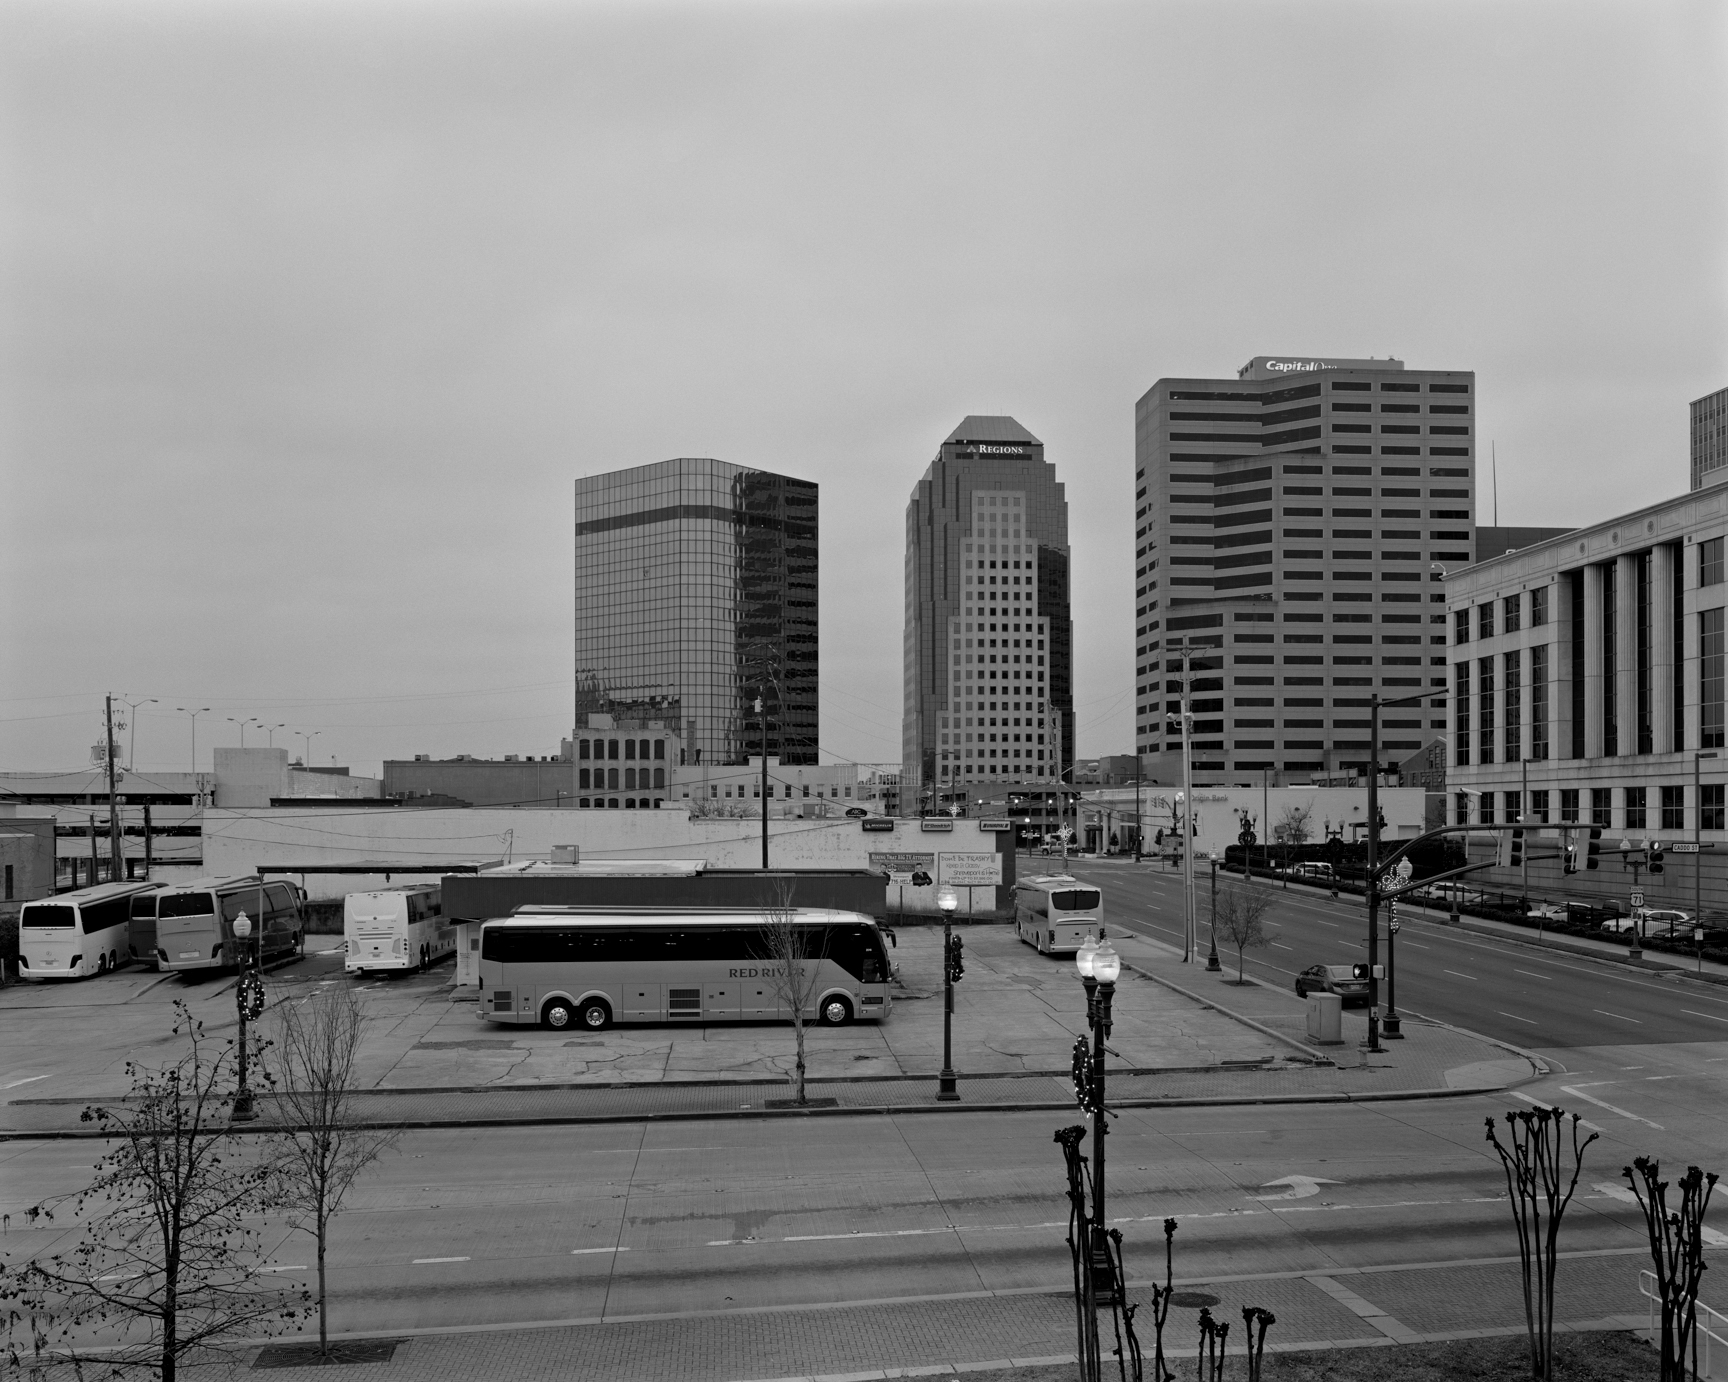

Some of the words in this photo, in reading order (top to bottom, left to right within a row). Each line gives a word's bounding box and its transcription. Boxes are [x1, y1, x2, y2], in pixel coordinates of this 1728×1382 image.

[979, 444, 1023, 454] REGIONS
[1633, 896, 1642, 904] 71
[729, 968, 758, 978] RED
[762, 968, 805, 978] RIVR
